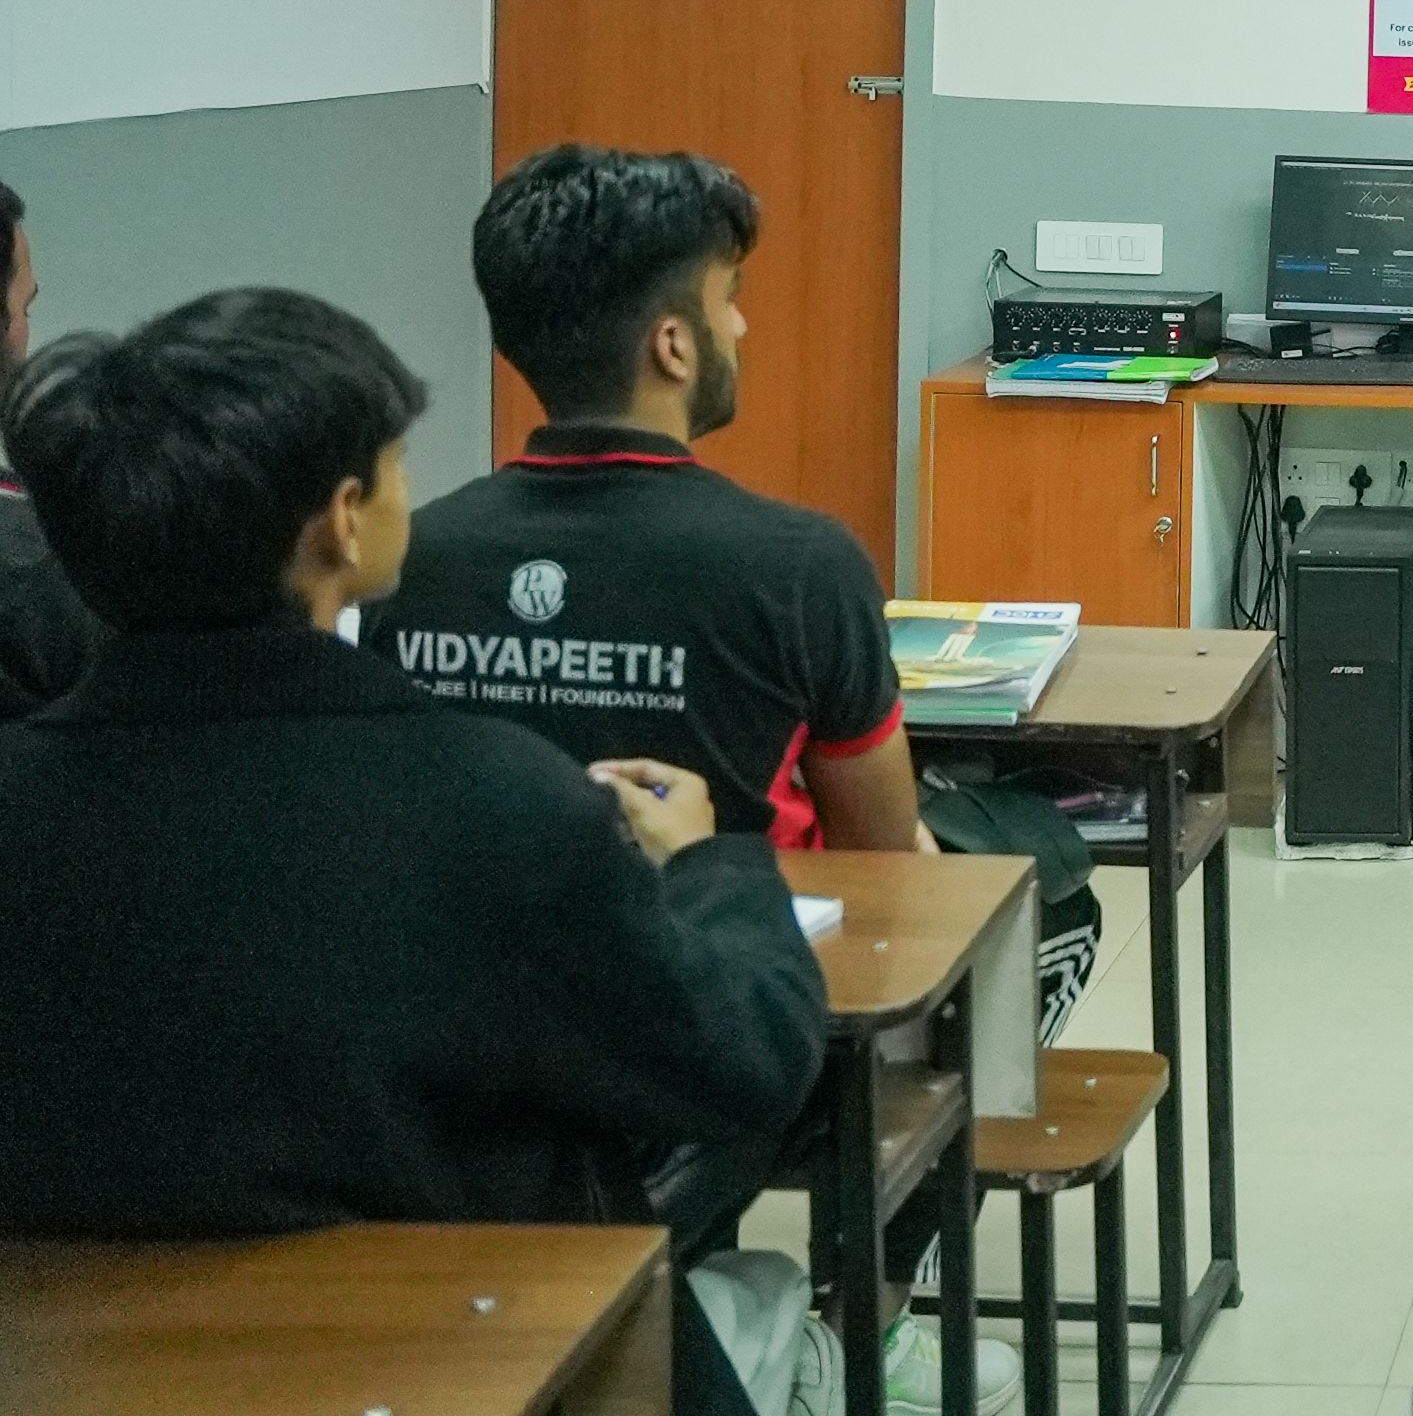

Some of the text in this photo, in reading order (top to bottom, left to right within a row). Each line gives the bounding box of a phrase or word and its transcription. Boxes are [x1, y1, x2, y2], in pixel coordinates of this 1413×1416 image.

[1390, 23, 1406, 32] For
[396, 629, 687, 689] VIDYAPEETH
[480, 684, 535, 703] NEET
[550, 687, 685, 712] FOUNDATION
